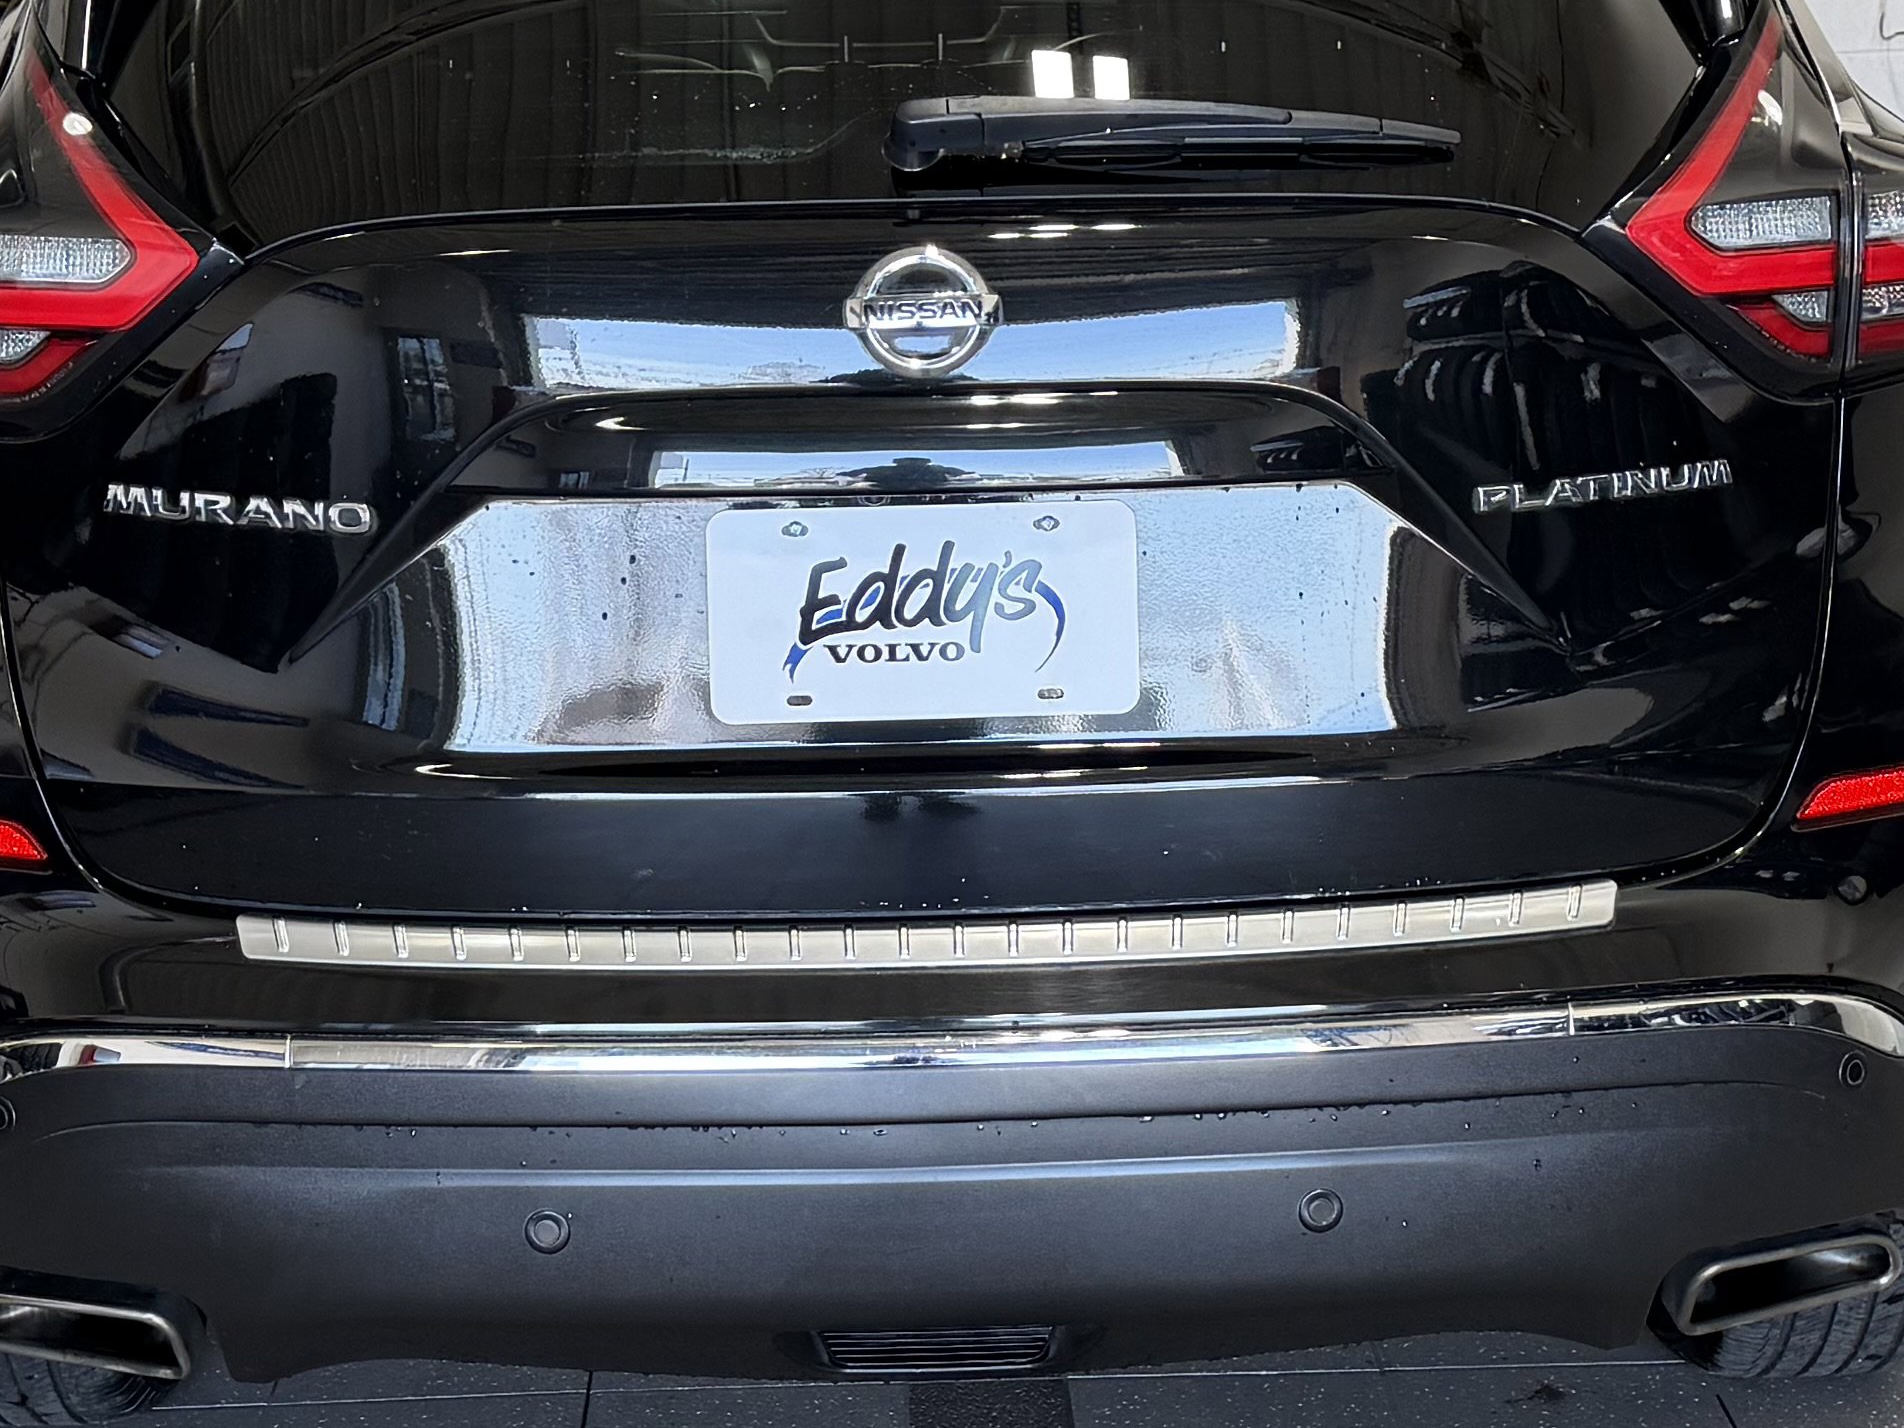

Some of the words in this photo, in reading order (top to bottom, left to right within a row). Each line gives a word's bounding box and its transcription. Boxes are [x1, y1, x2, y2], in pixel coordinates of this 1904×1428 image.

[863, 298, 984, 322] NISSAN
[103, 482, 377, 535] MURANO
[1473, 459, 1734, 513] PLATINUM
[799, 540, 1043, 654] Eddy's
[823, 641, 966, 664] VOLVO
